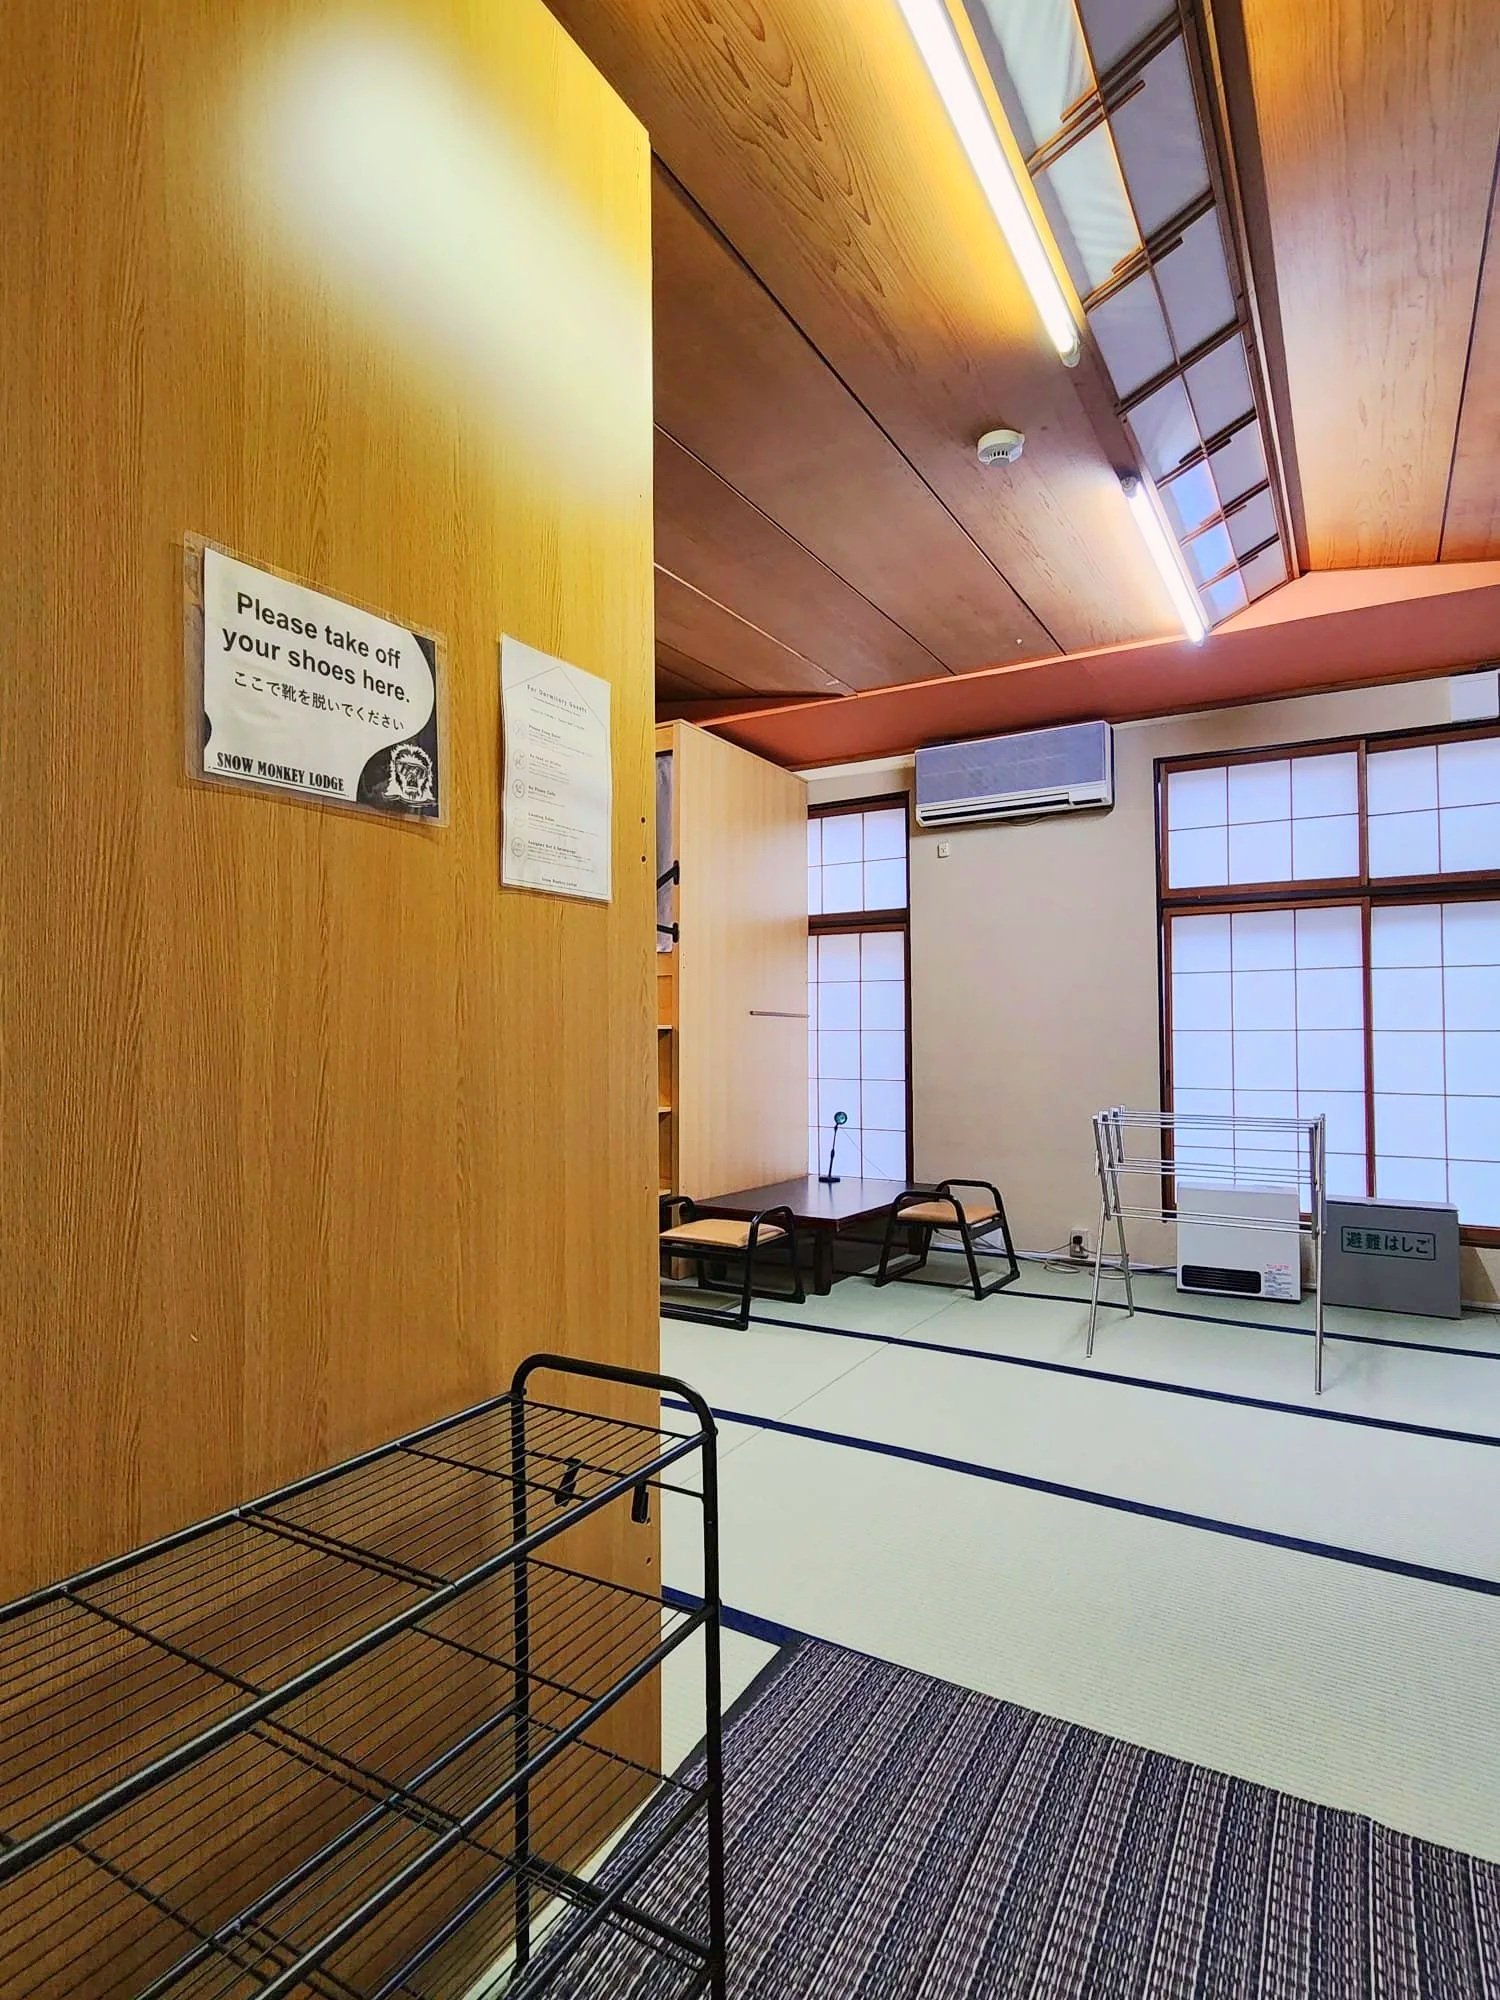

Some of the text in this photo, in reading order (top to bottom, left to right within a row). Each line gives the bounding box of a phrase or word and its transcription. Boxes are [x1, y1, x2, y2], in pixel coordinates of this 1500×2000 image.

[237, 591, 401, 669] Please take off
[222, 628, 410, 703] your shoes here.
[234, 671, 404, 731] ここで靴を脱いでください
[216, 752, 345, 792] SNOW MONKEY LODGE
[1346, 1232, 1430, 1253] 避難はしご
